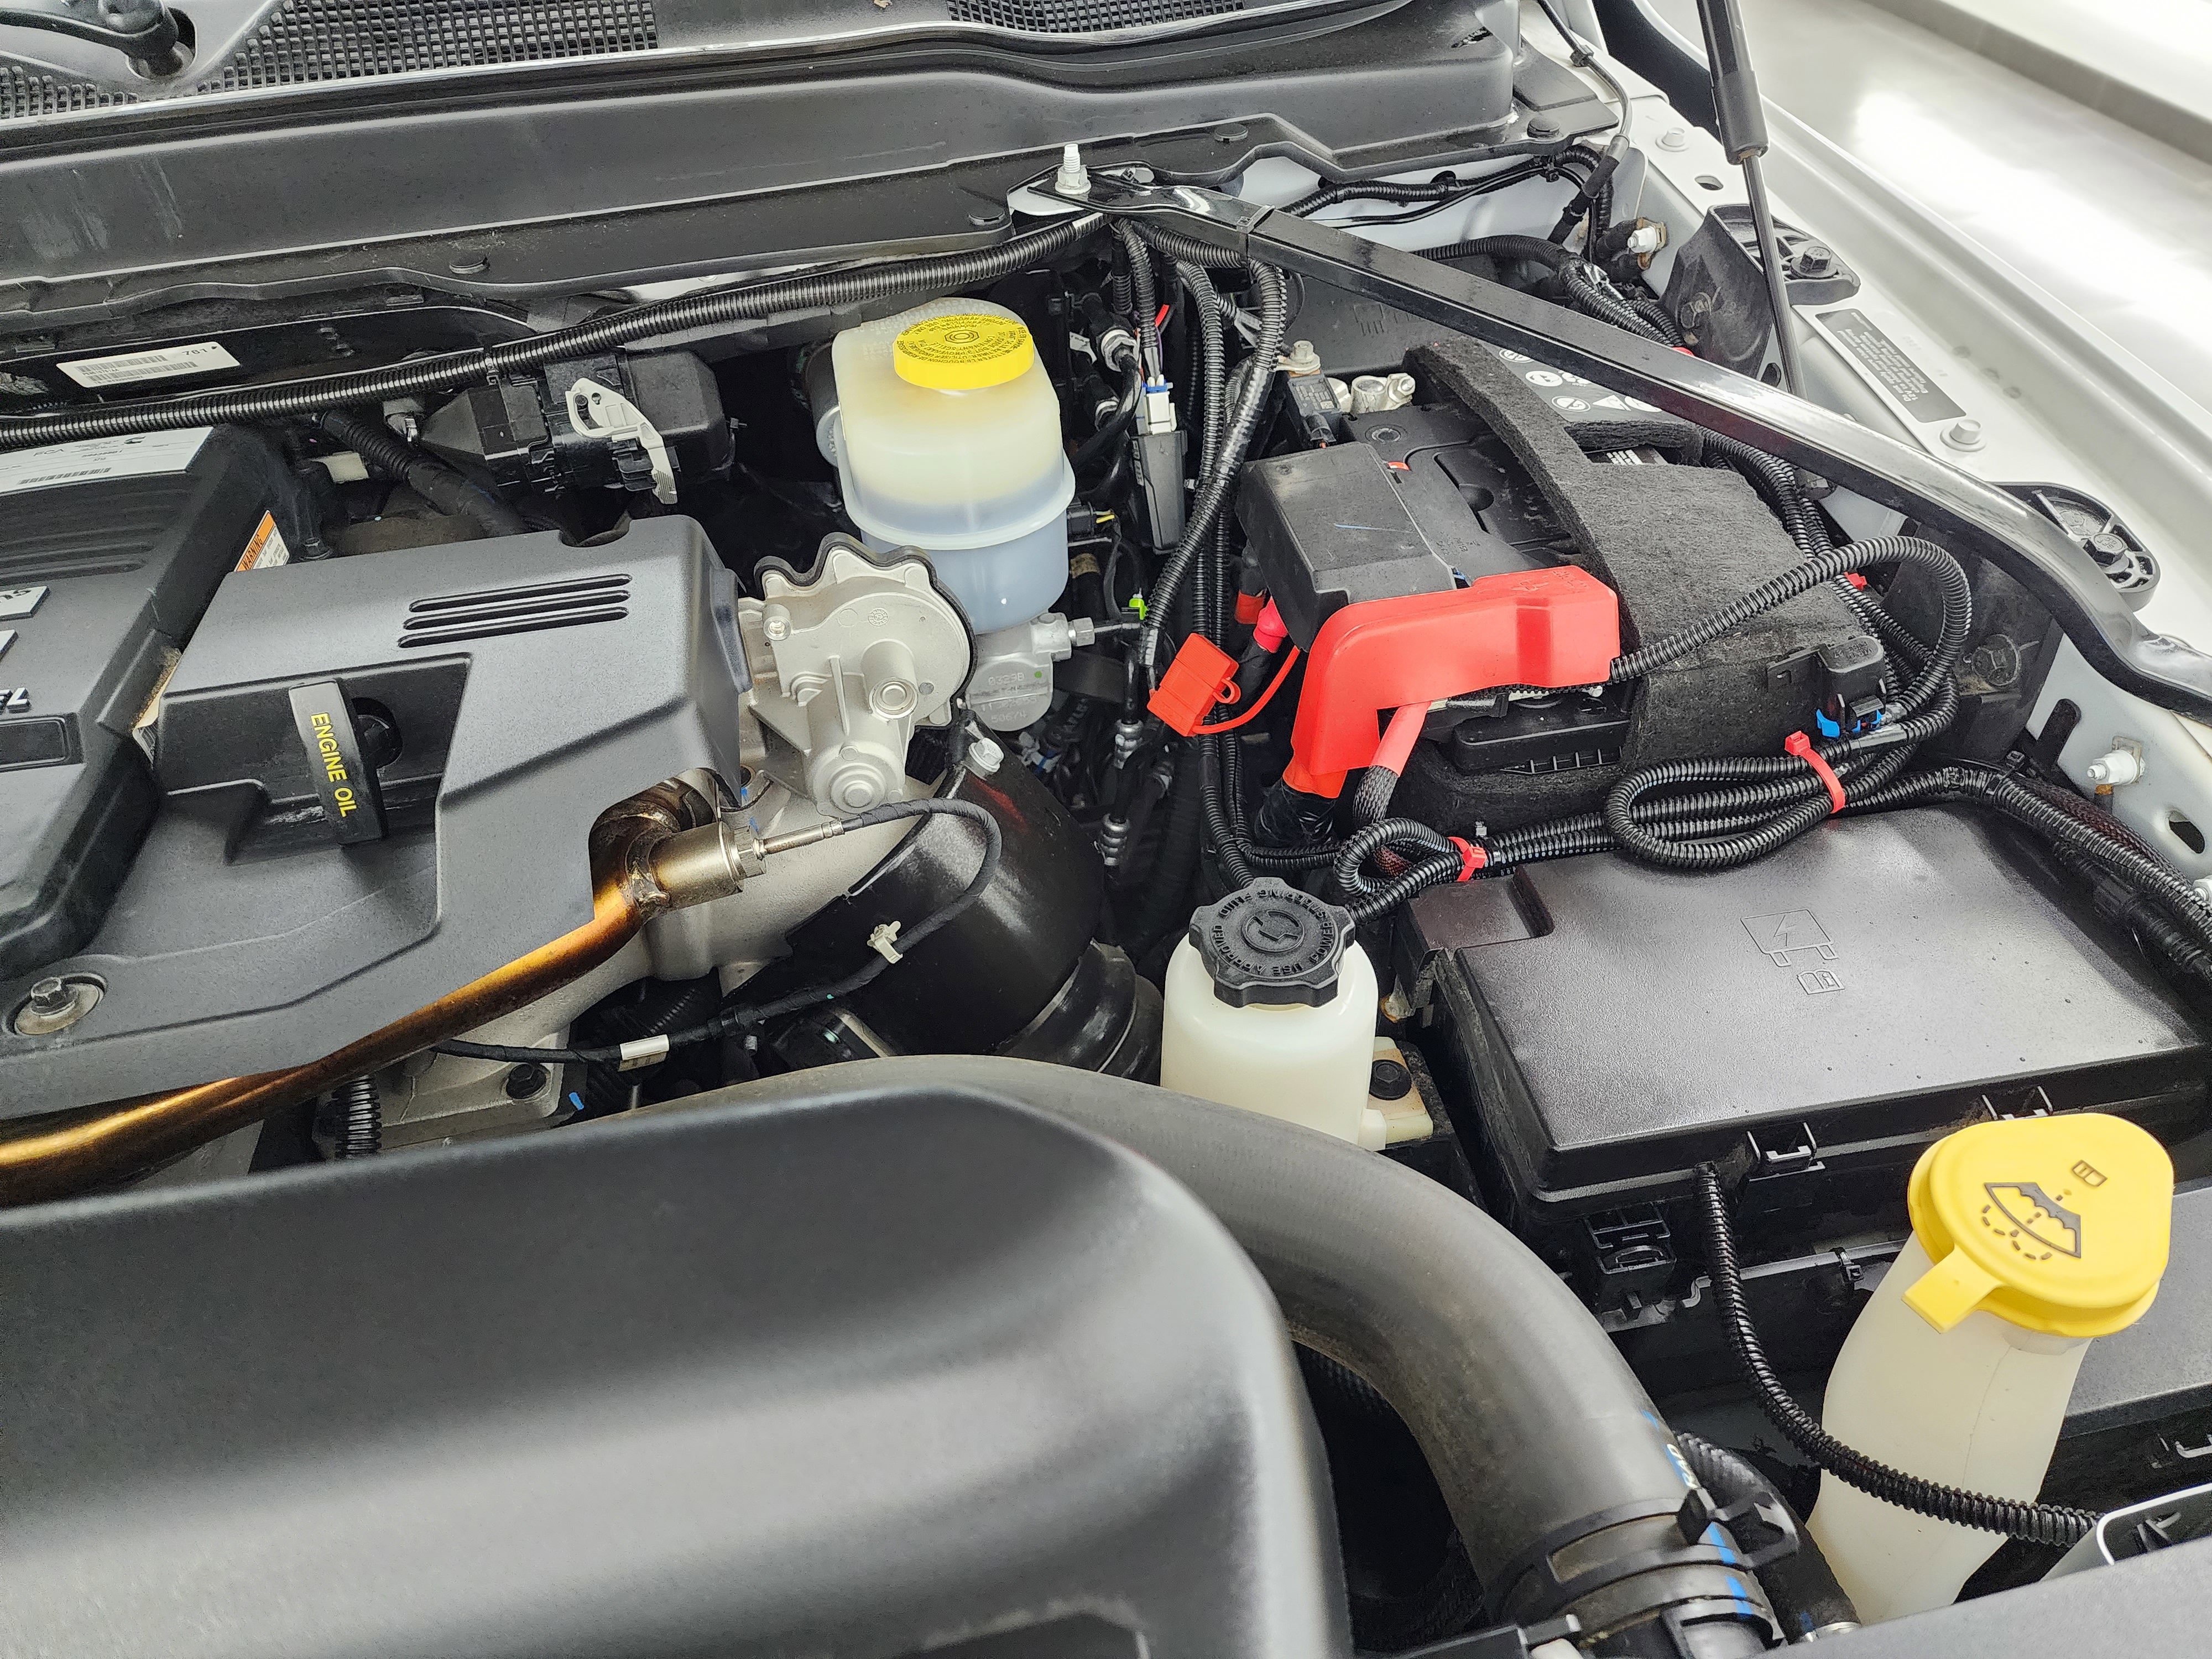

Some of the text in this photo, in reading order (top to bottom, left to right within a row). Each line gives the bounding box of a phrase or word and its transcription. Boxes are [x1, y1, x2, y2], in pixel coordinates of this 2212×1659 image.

[33, 448, 65, 457] FCA
[242, 534, 263, 570] WARNING
[311, 712, 357, 817] ENGINE OIL
[1211, 924, 1304, 975] USE APPROVED
[1218, 888, 1334, 964] POWER STEERING FLUID
